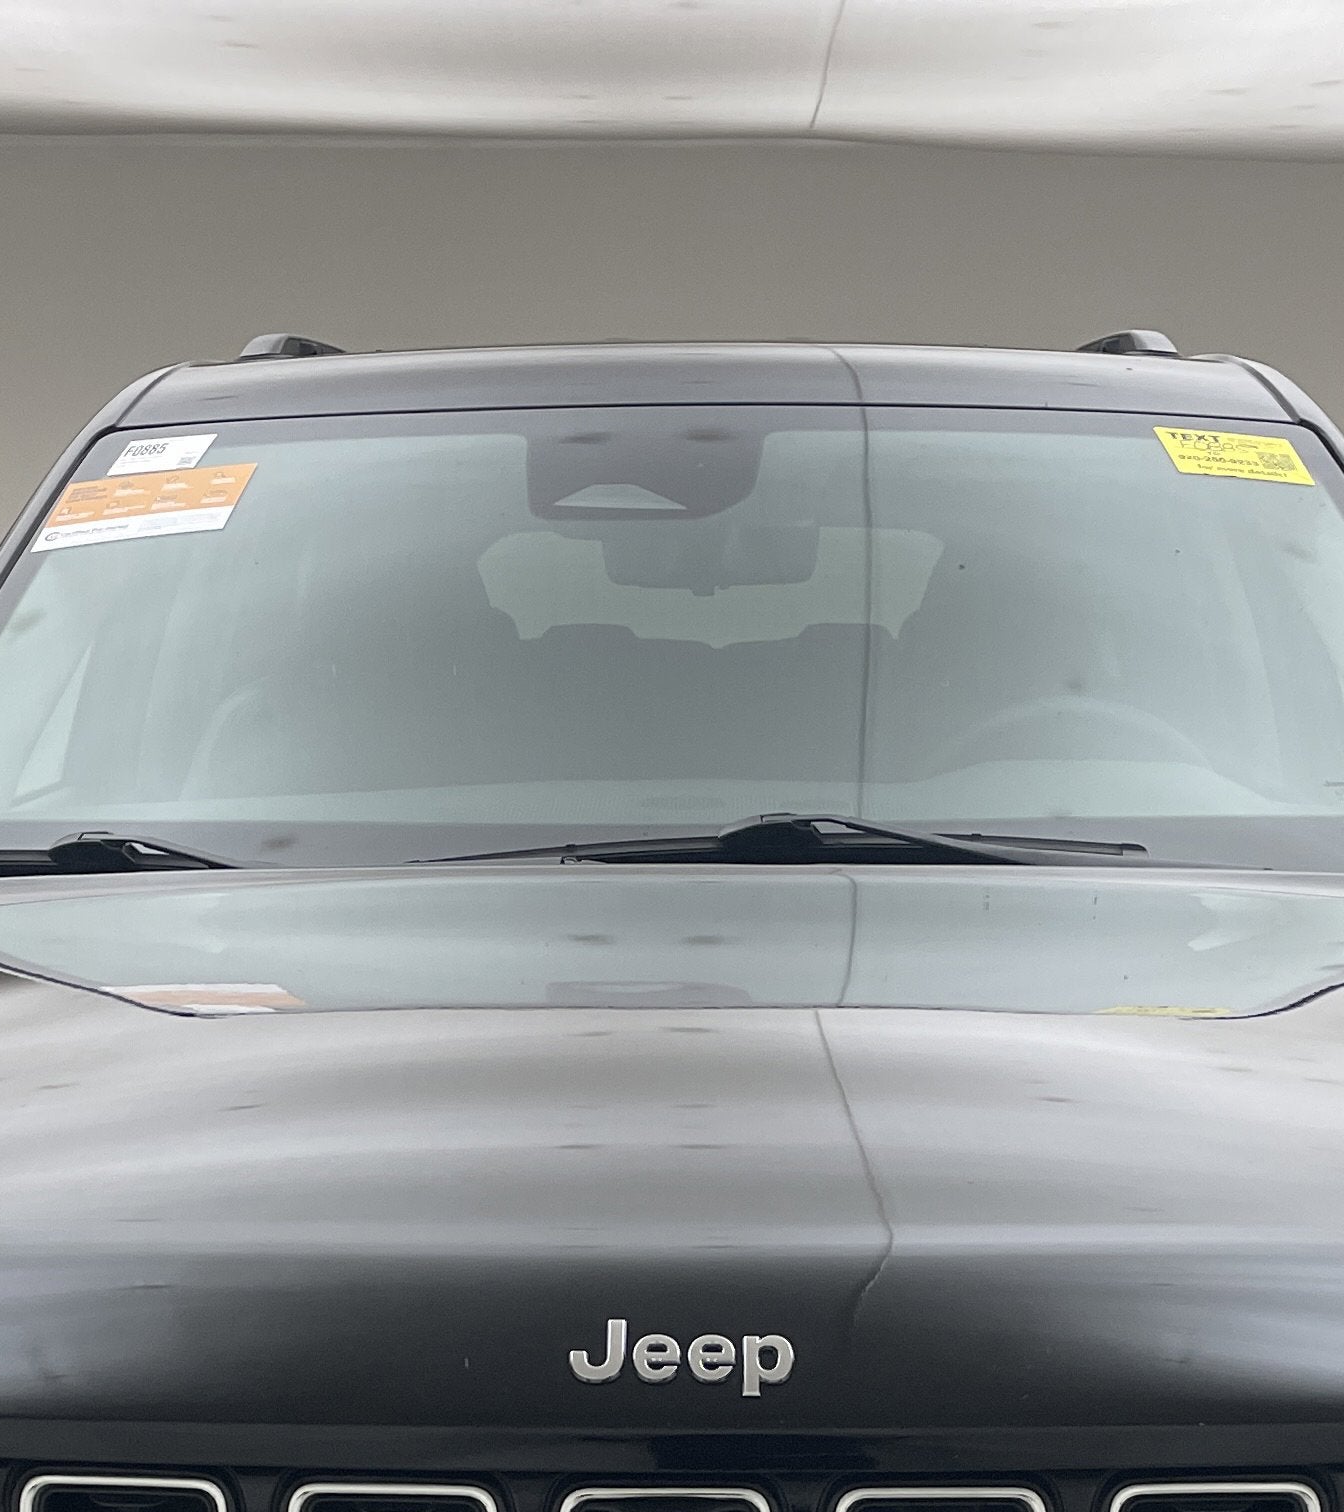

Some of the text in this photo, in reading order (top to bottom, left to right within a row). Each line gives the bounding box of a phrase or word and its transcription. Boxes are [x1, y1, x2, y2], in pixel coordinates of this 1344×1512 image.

[1166, 431, 1220, 443] TEXT
[123, 442, 170, 458] F0885
[568, 1318, 795, 1397] Jeep
